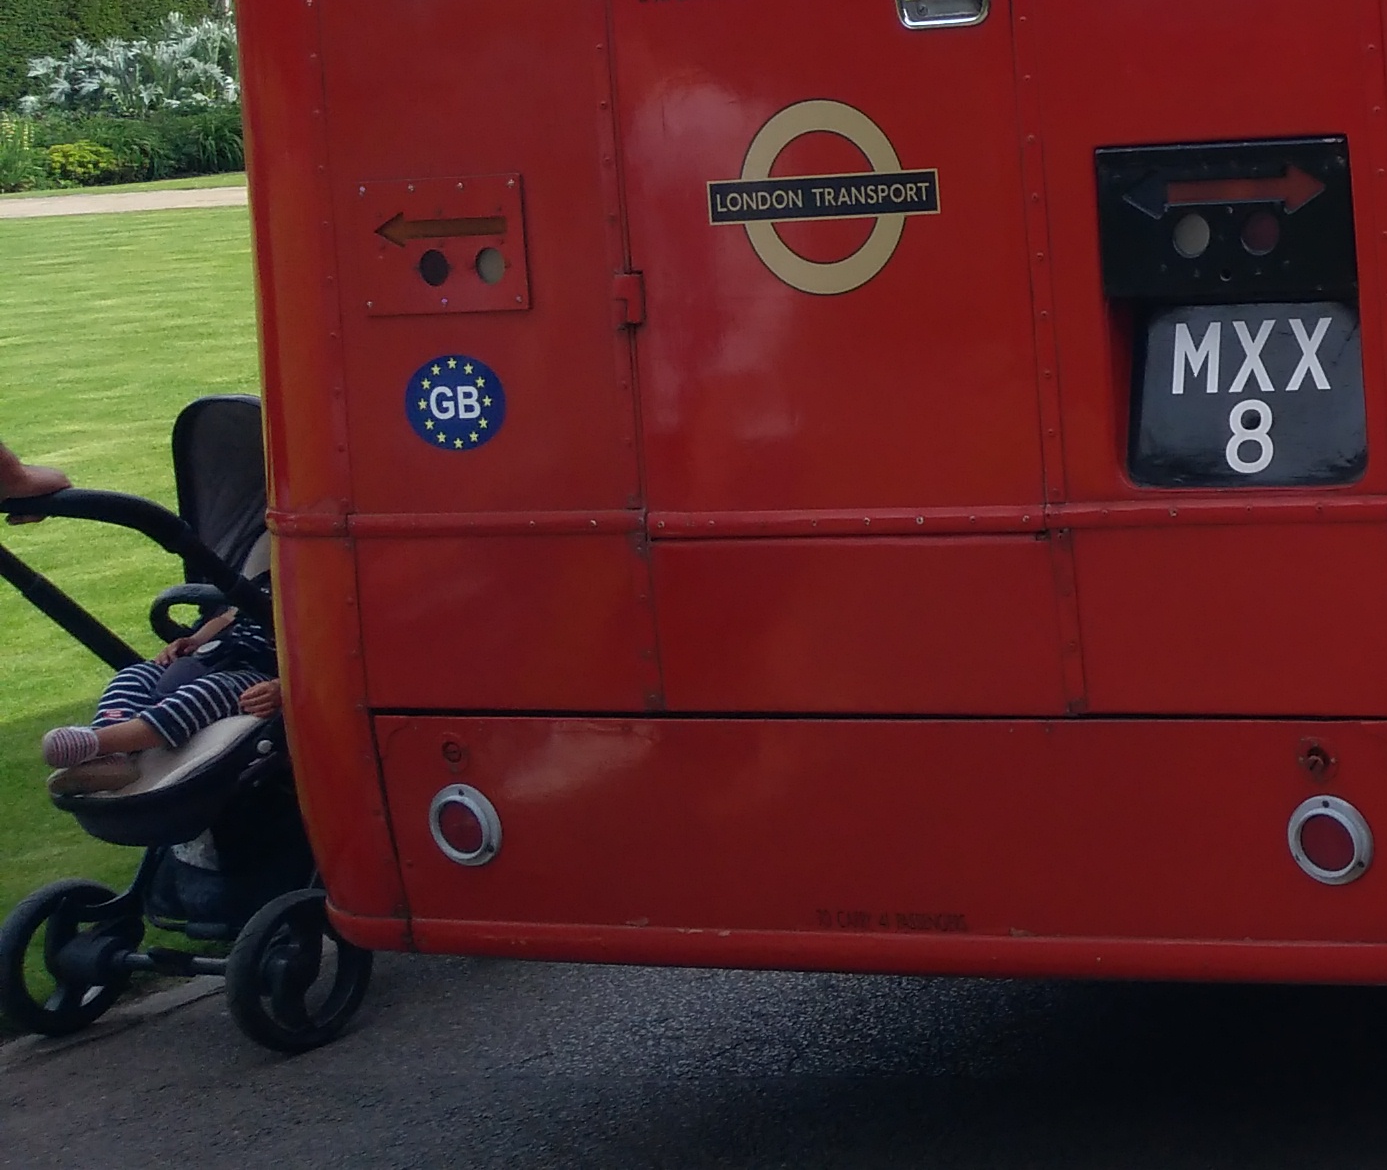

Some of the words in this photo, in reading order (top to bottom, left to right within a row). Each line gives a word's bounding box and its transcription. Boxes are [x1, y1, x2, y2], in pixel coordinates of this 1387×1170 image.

[715, 188, 804, 213] LONDON
[811, 182, 930, 207] TRANSPORT
[1171, 316, 1333, 395] MXX
[429, 385, 481, 420] GB
[1225, 398, 1275, 474] 8
